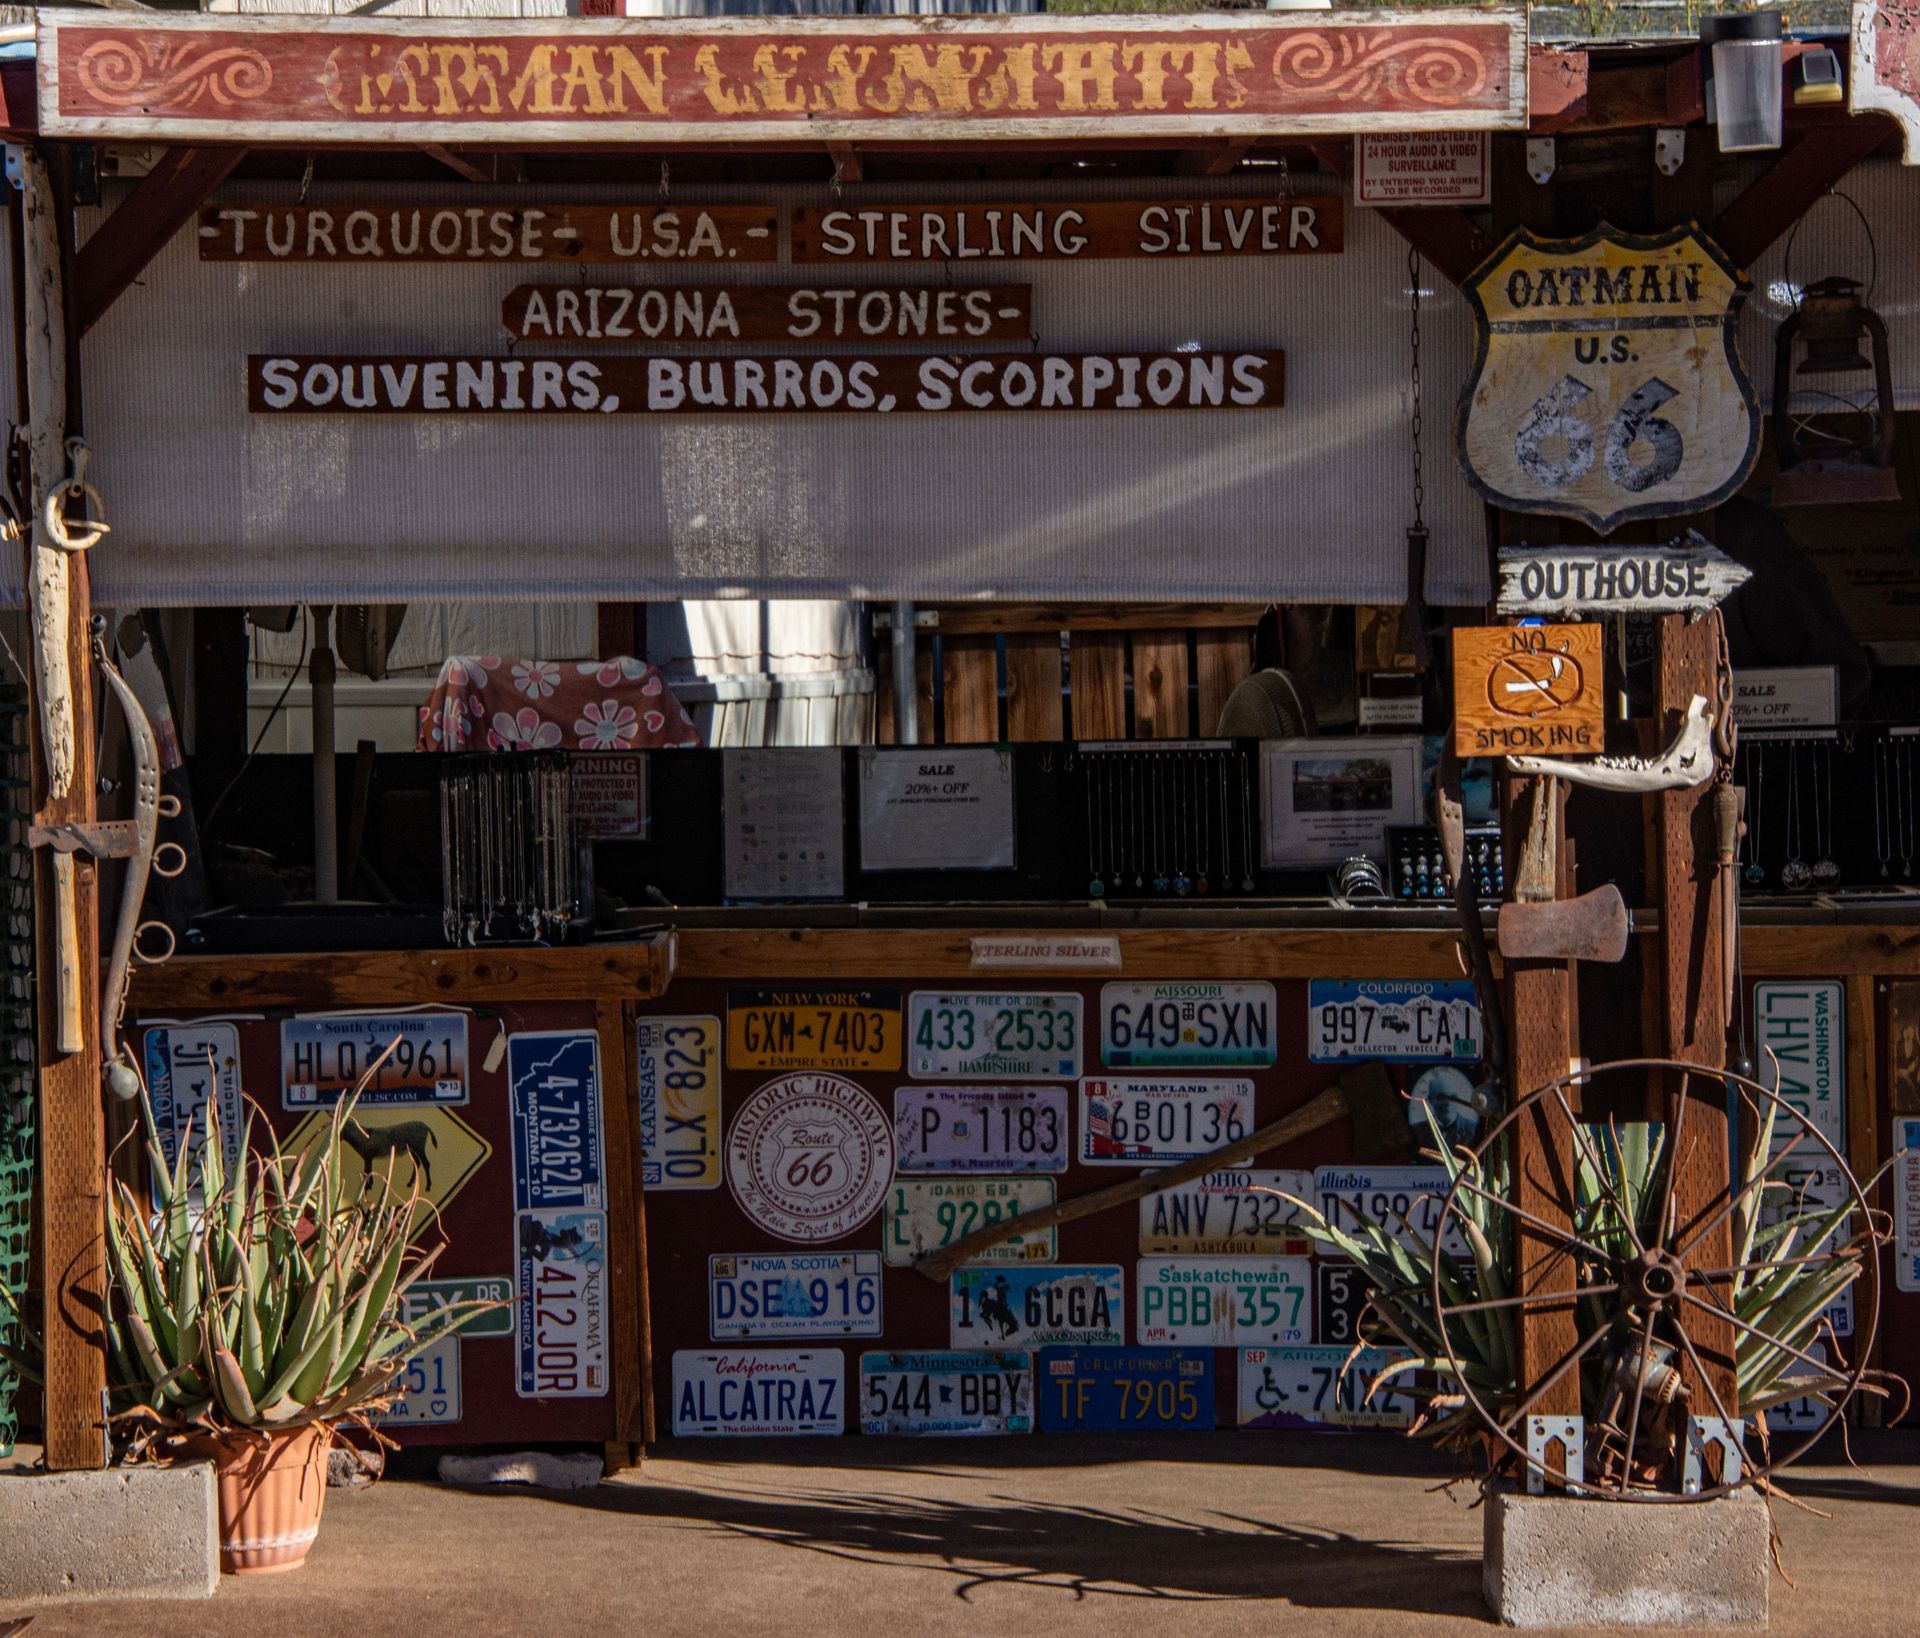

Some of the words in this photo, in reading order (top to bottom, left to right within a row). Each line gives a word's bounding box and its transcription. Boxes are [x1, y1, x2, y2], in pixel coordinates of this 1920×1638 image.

[1368, 146, 1379, 158] 24
[1382, 145, 1407, 157] HOUR
[1410, 145, 1437, 157] AUDIO
[1451, 144, 1477, 156] VIDEO
[1388, 159, 1457, 172] SURVEILLANCE
[1380, 178, 1425, 186] ENTERING
[1429, 177, 1447, 185] YOU
[1451, 177, 1479, 185] AGREE
[1384, 187, 1395, 195] TO
[1413, 186, 1461, 194] RECORDED
[821, 209, 1089, 258] STERLING
[1138, 202, 1320, 253] SILVER
[1505, 262, 1703, 309] OATMAN
[522, 288, 740, 338] ARIZONA
[1574, 335, 1640, 365] U.S.
[916, 354, 1269, 409] SCORPIONS
[1514, 373, 1684, 493] 66
[1520, 558, 1712, 600] OUTHOUSE
[1509, 630, 1547, 652] NO
[1737, 685, 1776, 697] SALE
[1763, 703, 1791, 715] OFF
[1475, 725, 1592, 749] SMOKING
[574, 758, 637, 774] RNING
[918, 765, 955, 776] SALE
[611, 790, 634, 800] VIDEO
[943, 782, 970, 794] OFF
[1055, 944, 1111, 957] SILVER
[1155, 986, 1222, 997] MISSOURI
[1358, 983, 1434, 994] COLORADO
[771, 992, 810, 1006] NEW
[814, 992, 859, 1006] YORK
[950, 996, 969, 1006] LIVE
[976, 996, 1000, 1006] FREE
[1006, 996, 1021, 1005] OR
[324, 1021, 363, 1034] South
[367, 1020, 425, 1033] Carolina
[745, 1011, 795, 1053] GXM
[816, 1012, 884, 1053] 7403
[916, 1009, 974, 1051] 433
[996, 1009, 1074, 1051] 2533
[1110, 1003, 1180, 1048] 649
[1198, 1003, 1268, 1048] SXN
[1322, 1006, 1376, 1044] 997
[1353, 1045, 1397, 1053] COLLECTOR
[1405, 1045, 1439, 1053] VEHICLE
[1815, 990, 1830, 1102] WASHINGTON
[294, 1041, 357, 1082] HLQ
[396, 1038, 458, 1079] 961
[664, 1027, 706, 1090] 823
[770, 1056, 817, 1067] EMPIRE
[821, 1056, 859, 1067] STATE
[959, 1060, 1033, 1073] HAMPSHIRE
[152, 1071, 172, 1121] YORK
[940, 1092, 955, 1100] The
[958, 1092, 994, 1101] Friendly
[998, 1092, 1024, 1100] Island
[1127, 1084, 1207, 1093] MARYLAND
[585, 1077, 597, 1135] TREASURE
[641, 1057, 660, 1148] KANSAS
[733, 1078, 803, 1150] HISTORIC
[814, 1078, 889, 1146] HIGHWAY
[527, 1091, 540, 1166] MONTANA
[790, 1129, 835, 1146] Route
[922, 1107, 941, 1153] P
[979, 1106, 1058, 1153] 1183
[589, 1138, 598, 1170] STATE
[969, 1159, 1014, 1168] Maarten
[786, 1151, 837, 1187] 66
[1826, 1169, 1841, 1188] OCT
[1202, 1173, 1252, 1187] OHIO
[930, 1185, 975, 1196] IDAHO
[756, 1202, 788, 1229] Main
[791, 1221, 829, 1236] Street
[1154, 1194, 1209, 1236] ANV
[1193, 1242, 1256, 1254] ASHTABULA
[751, 1258, 786, 1271] NOVA
[791, 1257, 840, 1270] SCOTIA
[520, 1259, 531, 1298] NATIVE
[1158, 1268, 1290, 1284] Saskatchewan
[476, 1284, 502, 1301] DR
[717, 1280, 783, 1319] DSE
[809, 1277, 875, 1315] 916
[580, 1257, 602, 1351] OKLAHOMA
[1024, 1285, 1111, 1328] 6CGA
[1143, 1286, 1212, 1327] PBB
[1236, 1286, 1304, 1327] 357
[521, 1300, 532, 1351] AMERICA
[771, 1321, 805, 1329] OCEAN
[810, 1319, 875, 1328] PLAYGROUND
[1146, 1328, 1166, 1339] APR
[1033, 1329, 1114, 1342] WYOMING
[715, 1355, 806, 1378] California
[910, 1355, 989, 1370] Minnesota
[1246, 1351, 1265, 1364] SEP
[679, 1379, 837, 1422] ALCATRAZ
[869, 1375, 931, 1417] 544
[960, 1374, 1022, 1415] BBY
[1055, 1378, 1096, 1420] TF
[1113, 1379, 1199, 1422] 7905
[723, 1425, 739, 1433] The
[740, 1425, 771, 1433] Golden
[772, 1425, 794, 1433] State
